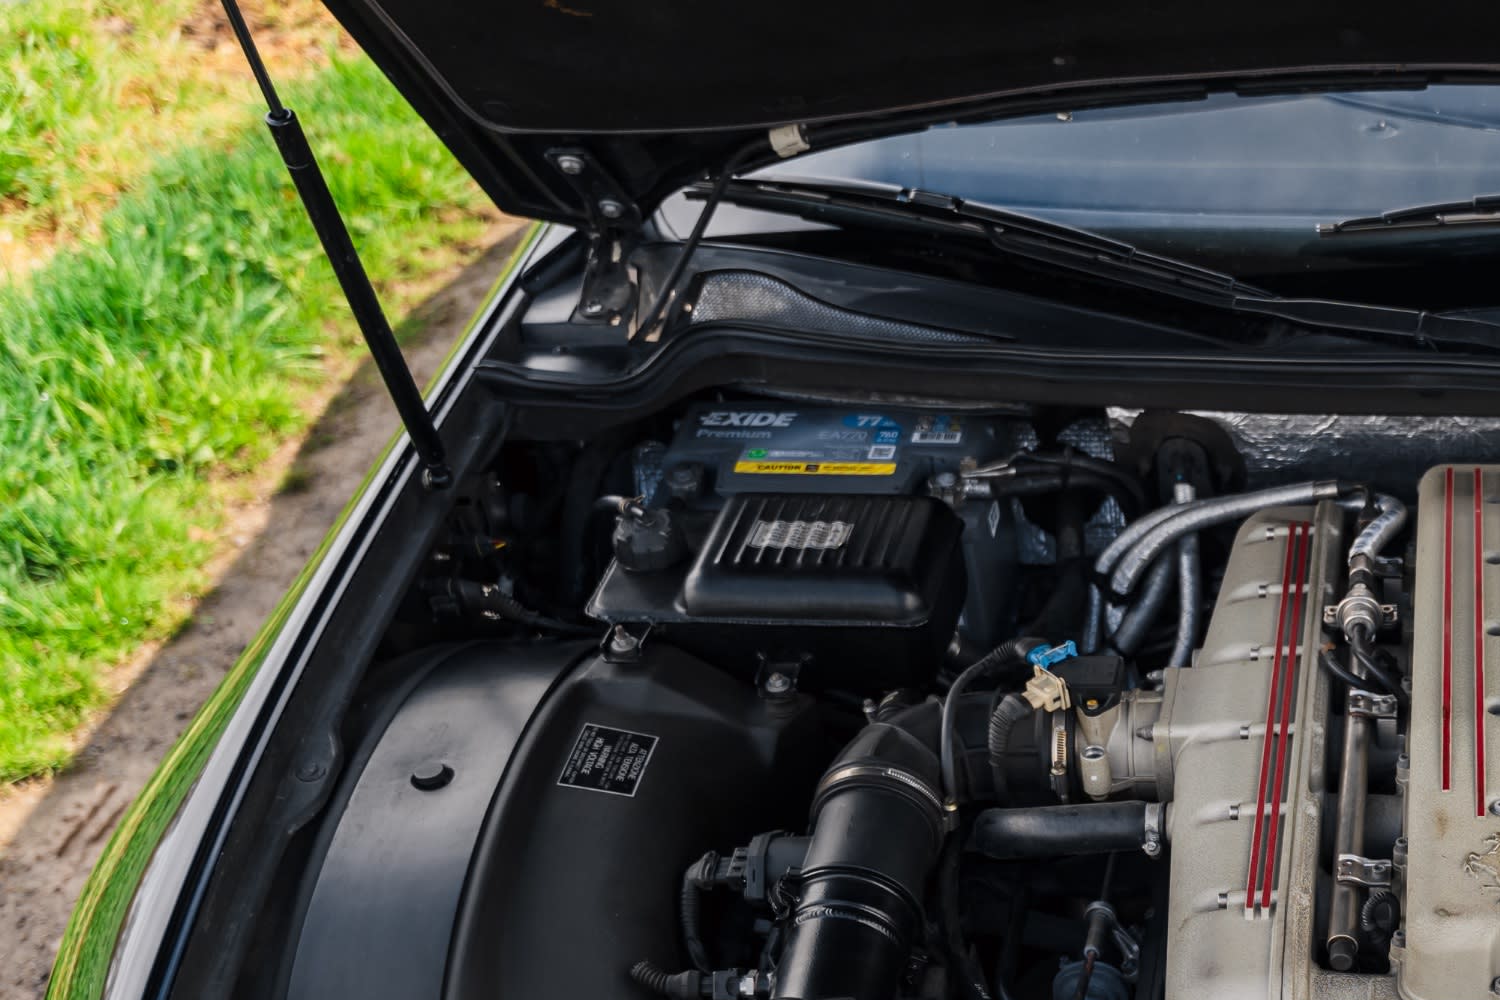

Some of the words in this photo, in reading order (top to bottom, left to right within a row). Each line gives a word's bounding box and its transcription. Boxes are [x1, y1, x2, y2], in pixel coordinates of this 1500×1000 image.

[701, 412, 797, 427] EXIDE
[858, 415, 883, 427] 77
[696, 429, 772, 439] Premium
[817, 431, 868, 440] EA770
